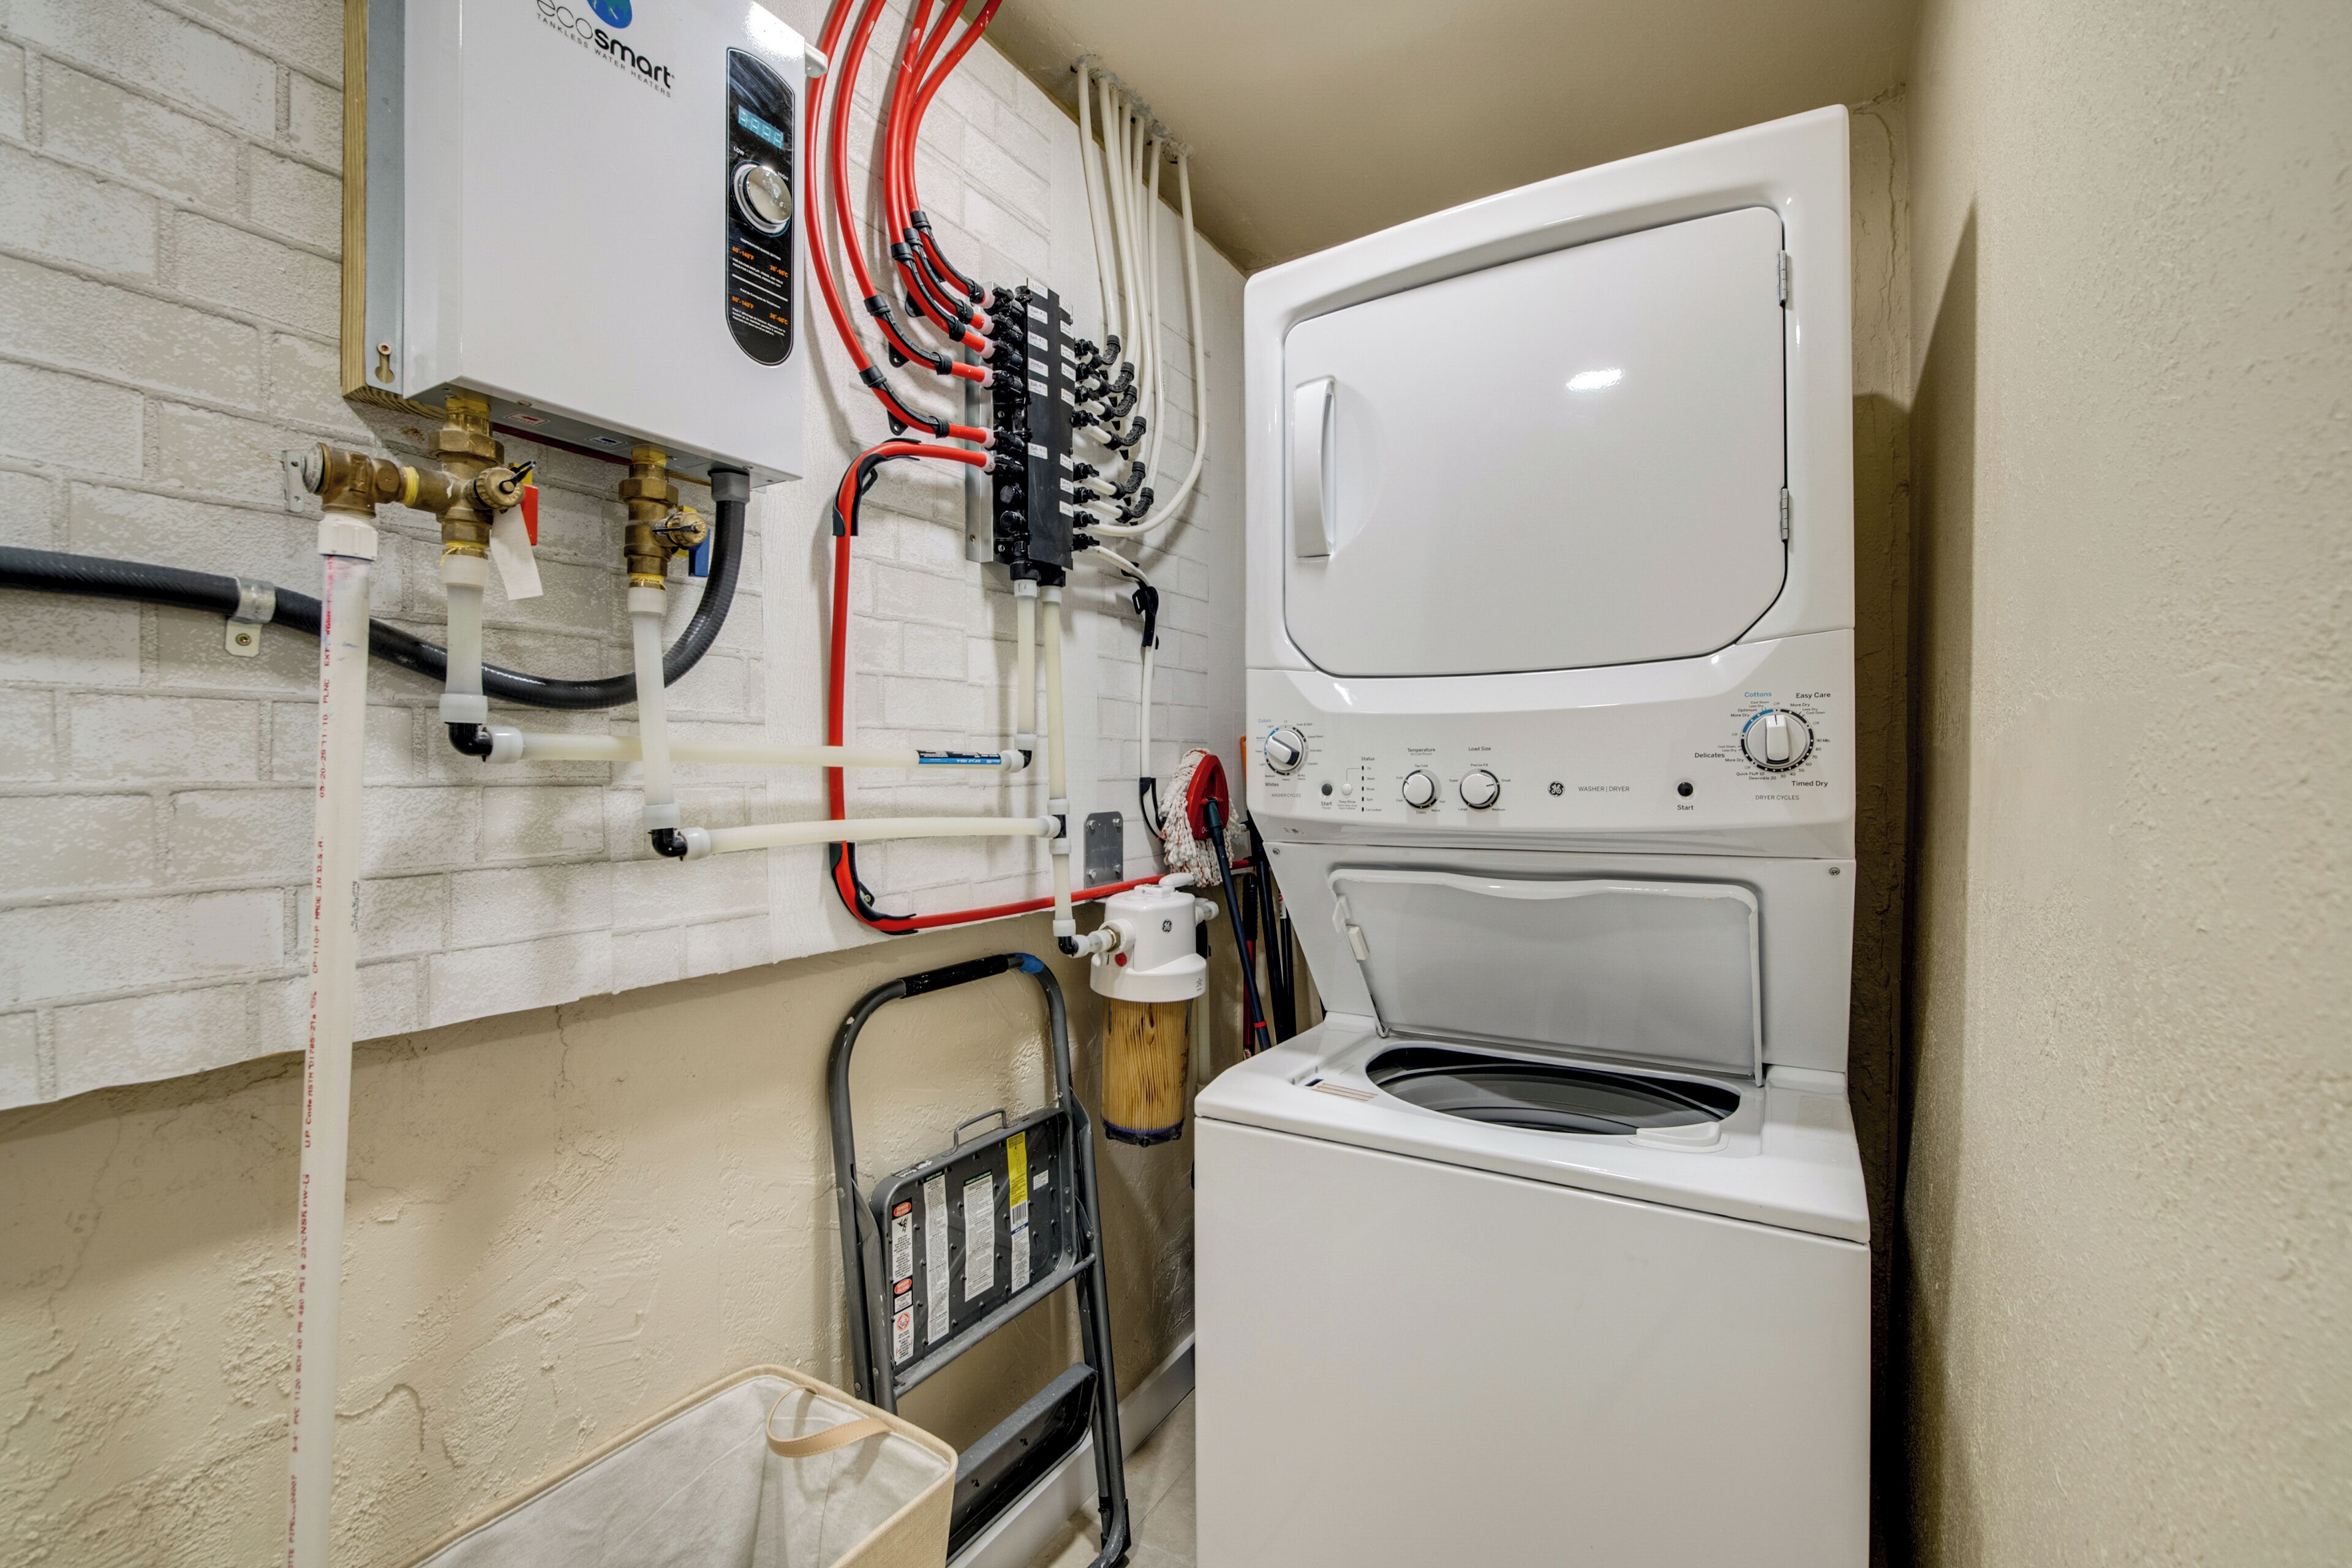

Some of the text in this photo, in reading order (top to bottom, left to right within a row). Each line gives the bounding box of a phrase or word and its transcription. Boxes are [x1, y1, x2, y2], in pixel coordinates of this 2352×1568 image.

[537, 13, 671, 98] TANKLESS WATER HEATERS
[734, 146, 744, 156] LOW
[778, 172, 788, 181] HIGH
[316, 876, 322, 889] IN
[297, 1322, 303, 1333] PR
[296, 1340, 302, 1351] 40
